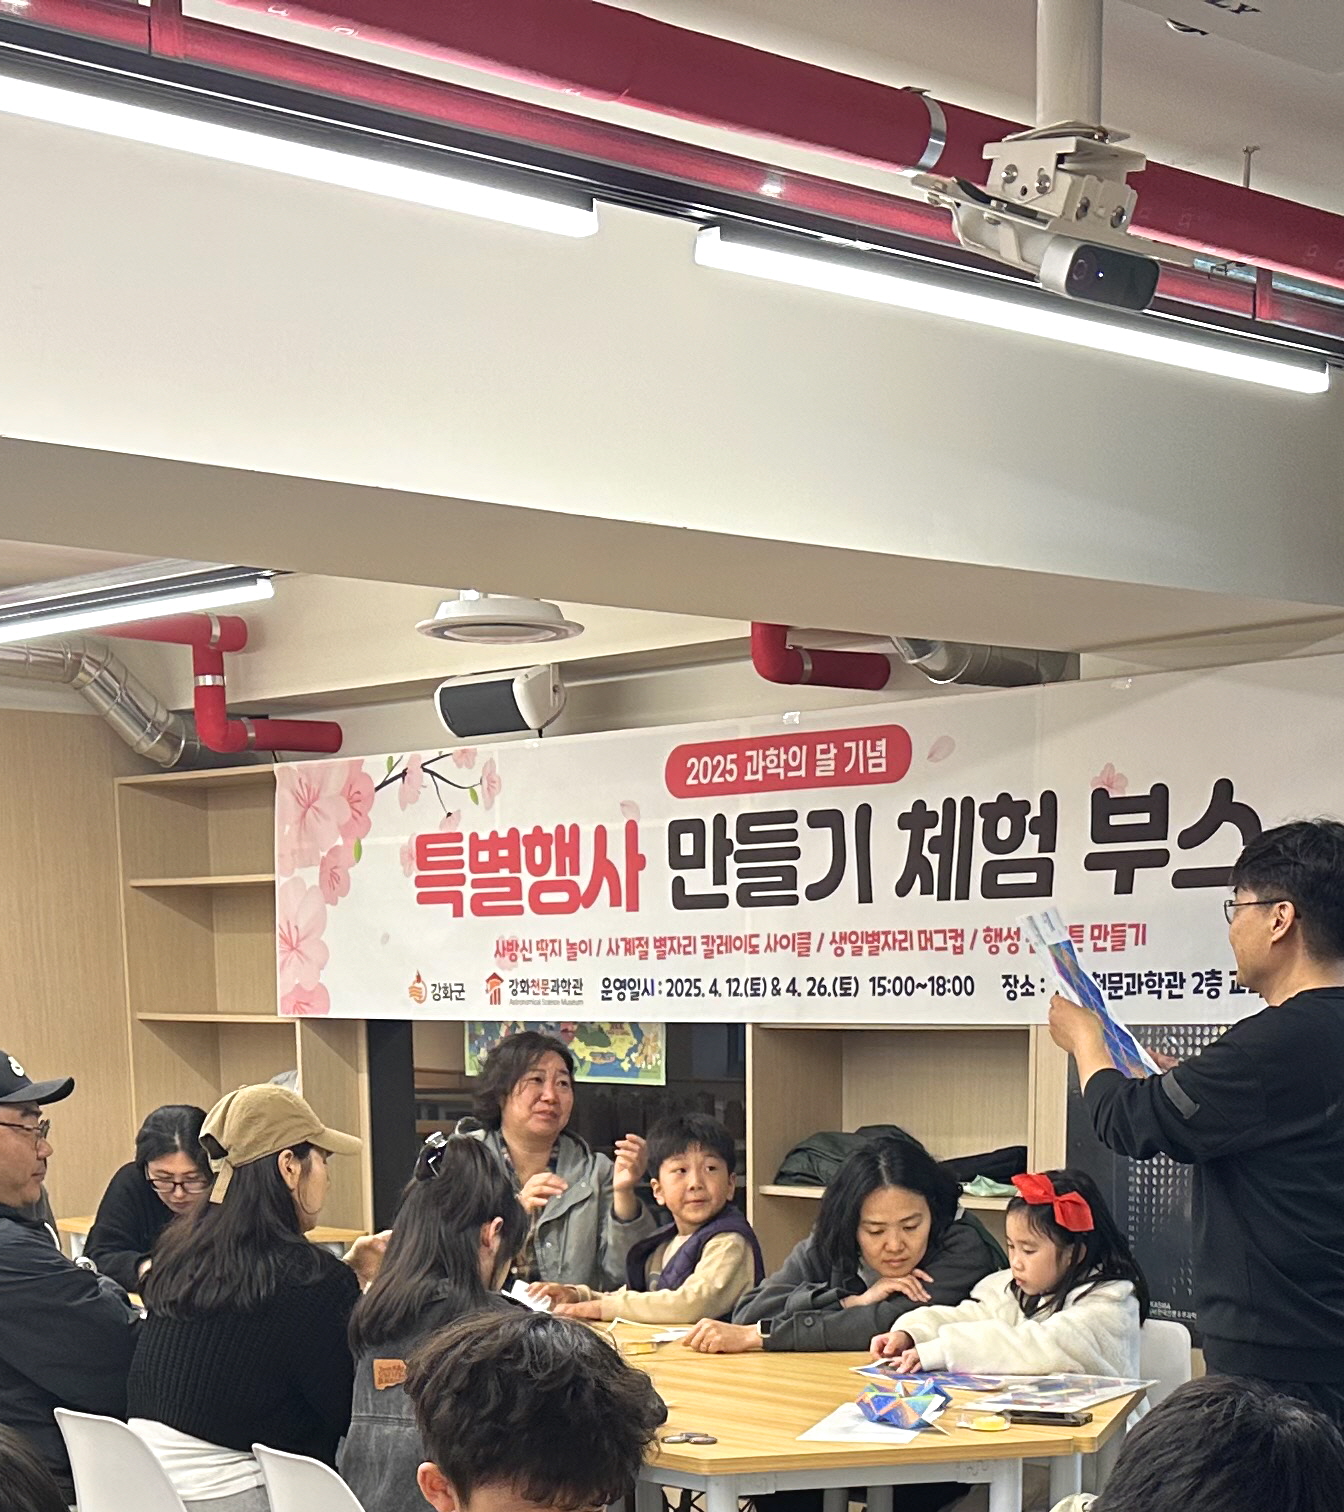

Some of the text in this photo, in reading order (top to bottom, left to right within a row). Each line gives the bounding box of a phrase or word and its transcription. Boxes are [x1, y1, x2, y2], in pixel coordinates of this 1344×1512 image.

[685, 738, 887, 786] 2025 과학의 달 기념
[414, 777, 1263, 918] 특별행사 만들기 체험 부스
[494, 938, 532, 962] 사방신
[536, 938, 562, 962] 딱지
[565, 938, 593, 961] 놀이
[605, 937, 649, 961] 사계절
[653, 935, 697, 960] 별자리
[701, 934, 761, 959] 칼레이도
[764, 931, 812, 958] 사이클
[829, 929, 914, 957] 생일별자리
[917, 928, 965, 955] 머그컵
[982, 926, 1021, 955] 행성
[1090, 923, 1147, 953] 만들기
[431, 983, 467, 1002] 강화군
[508, 978, 584, 997] 강화천문과학관
[601, 977, 655, 1001] 운영일시
[665, 978, 705, 998] 2025.
[708, 977, 722, 998] 4.
[725, 976, 767, 998] 12.(토)
[786, 977, 802, 998] 4.
[806, 976, 859, 998] 26.(토)
[868, 975, 975, 998] 15:00~18:00
[1001, 974, 1035, 1001] 장소
[1191, 968, 1223, 1000] 2층
